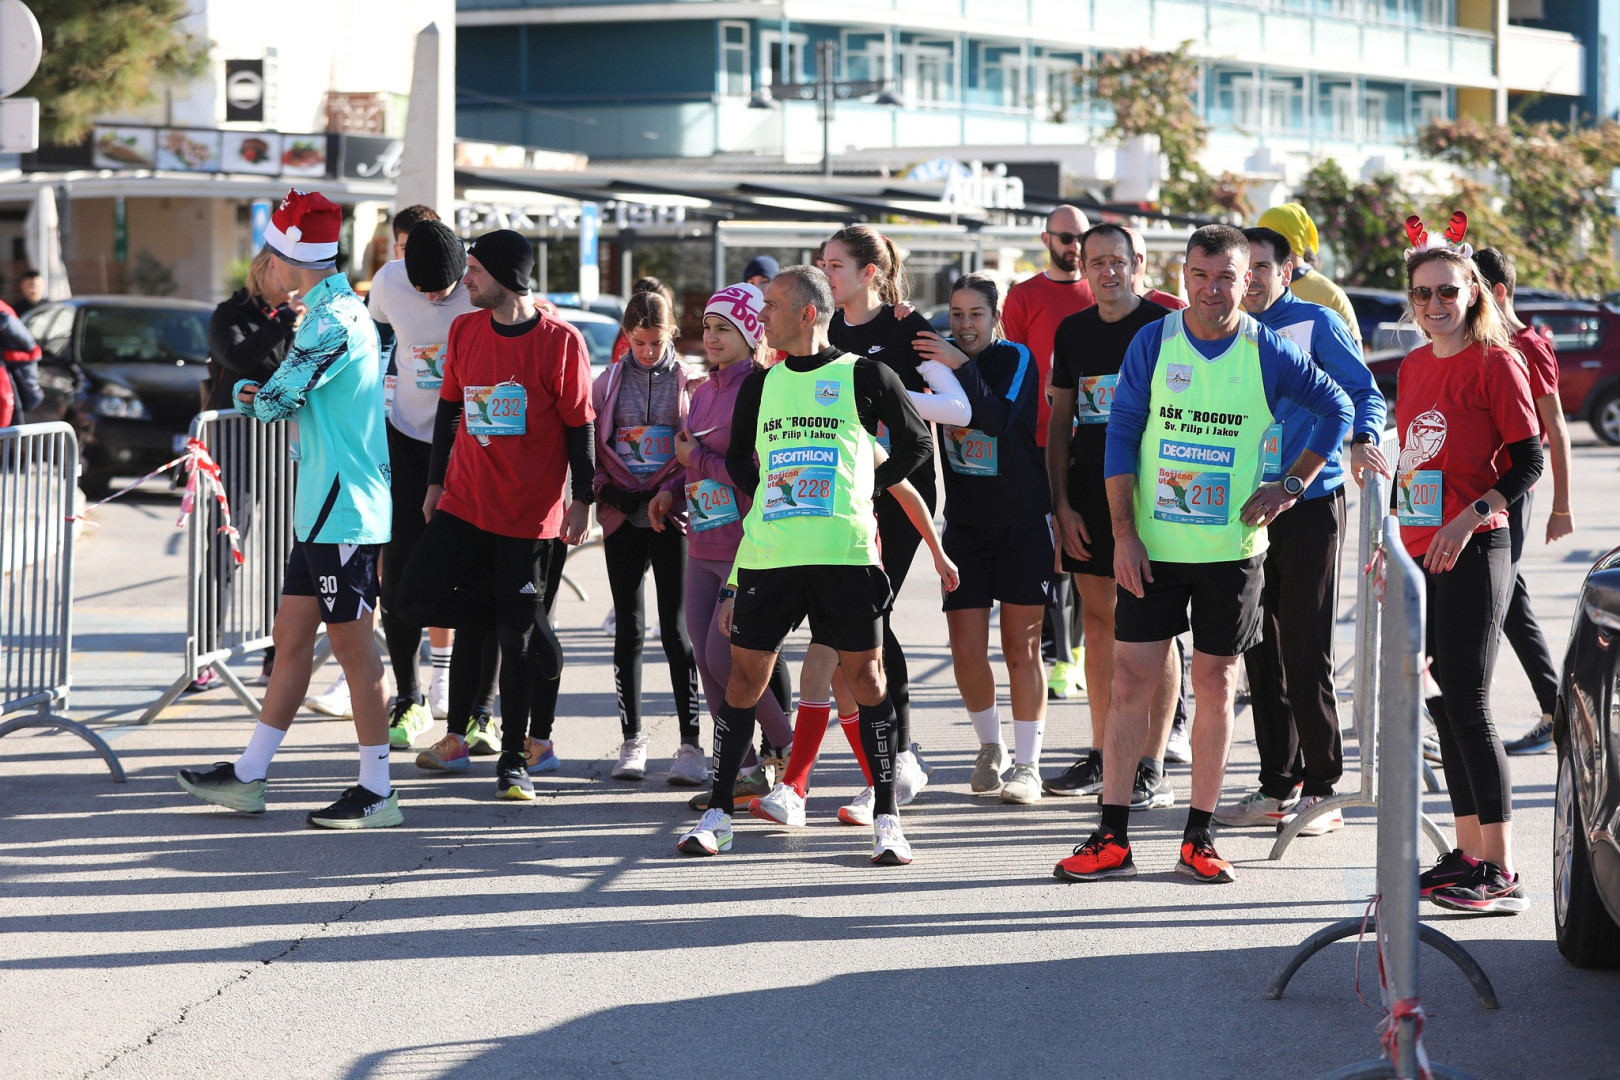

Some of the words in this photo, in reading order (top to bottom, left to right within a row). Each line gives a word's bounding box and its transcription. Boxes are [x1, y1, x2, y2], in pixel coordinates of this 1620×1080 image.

[1098, 386, 1115, 405] 21
[492, 398, 521, 417] 232
[1159, 404, 1183, 420] AŠK
[763, 417, 783, 433] AŠK
[1164, 421, 1177, 431] Sv.
[1180, 423, 1203, 435] Filip
[1205, 426, 1210, 434] i
[1212, 427, 1239, 437] Jakov
[769, 433, 780, 442] Sv.
[782, 430, 801, 440] Filip
[804, 429, 808, 437] i
[810, 430, 837, 440] Jakov
[644, 437, 672, 455] 218
[965, 440, 992, 459] 231
[1163, 443, 1231, 463] DECATHLON
[771, 450, 834, 466] DECATHLON
[701, 486, 731, 510] 249
[797, 479, 830, 498] 228
[1191, 485, 1225, 506] 213
[1413, 484, 1438, 506] 207
[319, 575, 338, 594] 30
[614, 664, 628, 725] NIKE
[689, 668, 699, 726] NIKE
[871, 720, 893, 783] kalenji
